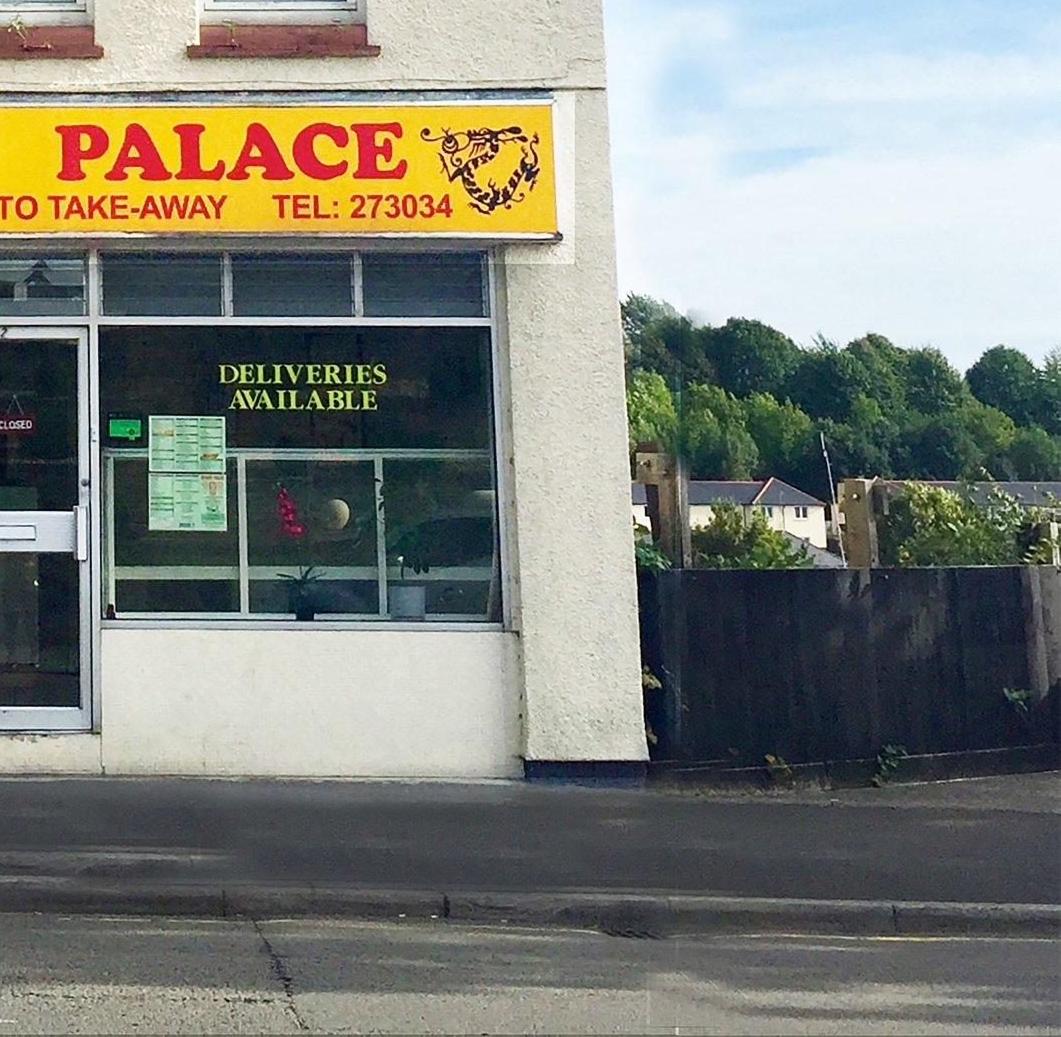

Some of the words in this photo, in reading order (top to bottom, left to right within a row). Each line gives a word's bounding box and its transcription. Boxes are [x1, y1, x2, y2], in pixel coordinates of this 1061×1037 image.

[55, 122, 408, 182] PALACE
[48, 194, 228, 220] TAKE-AWAY
[272, 194, 339, 220] TEL:
[350, 193, 454, 219] 273034
[218, 363, 387, 385] DELIVERIES
[228, 389, 378, 411] AVAILABLE
